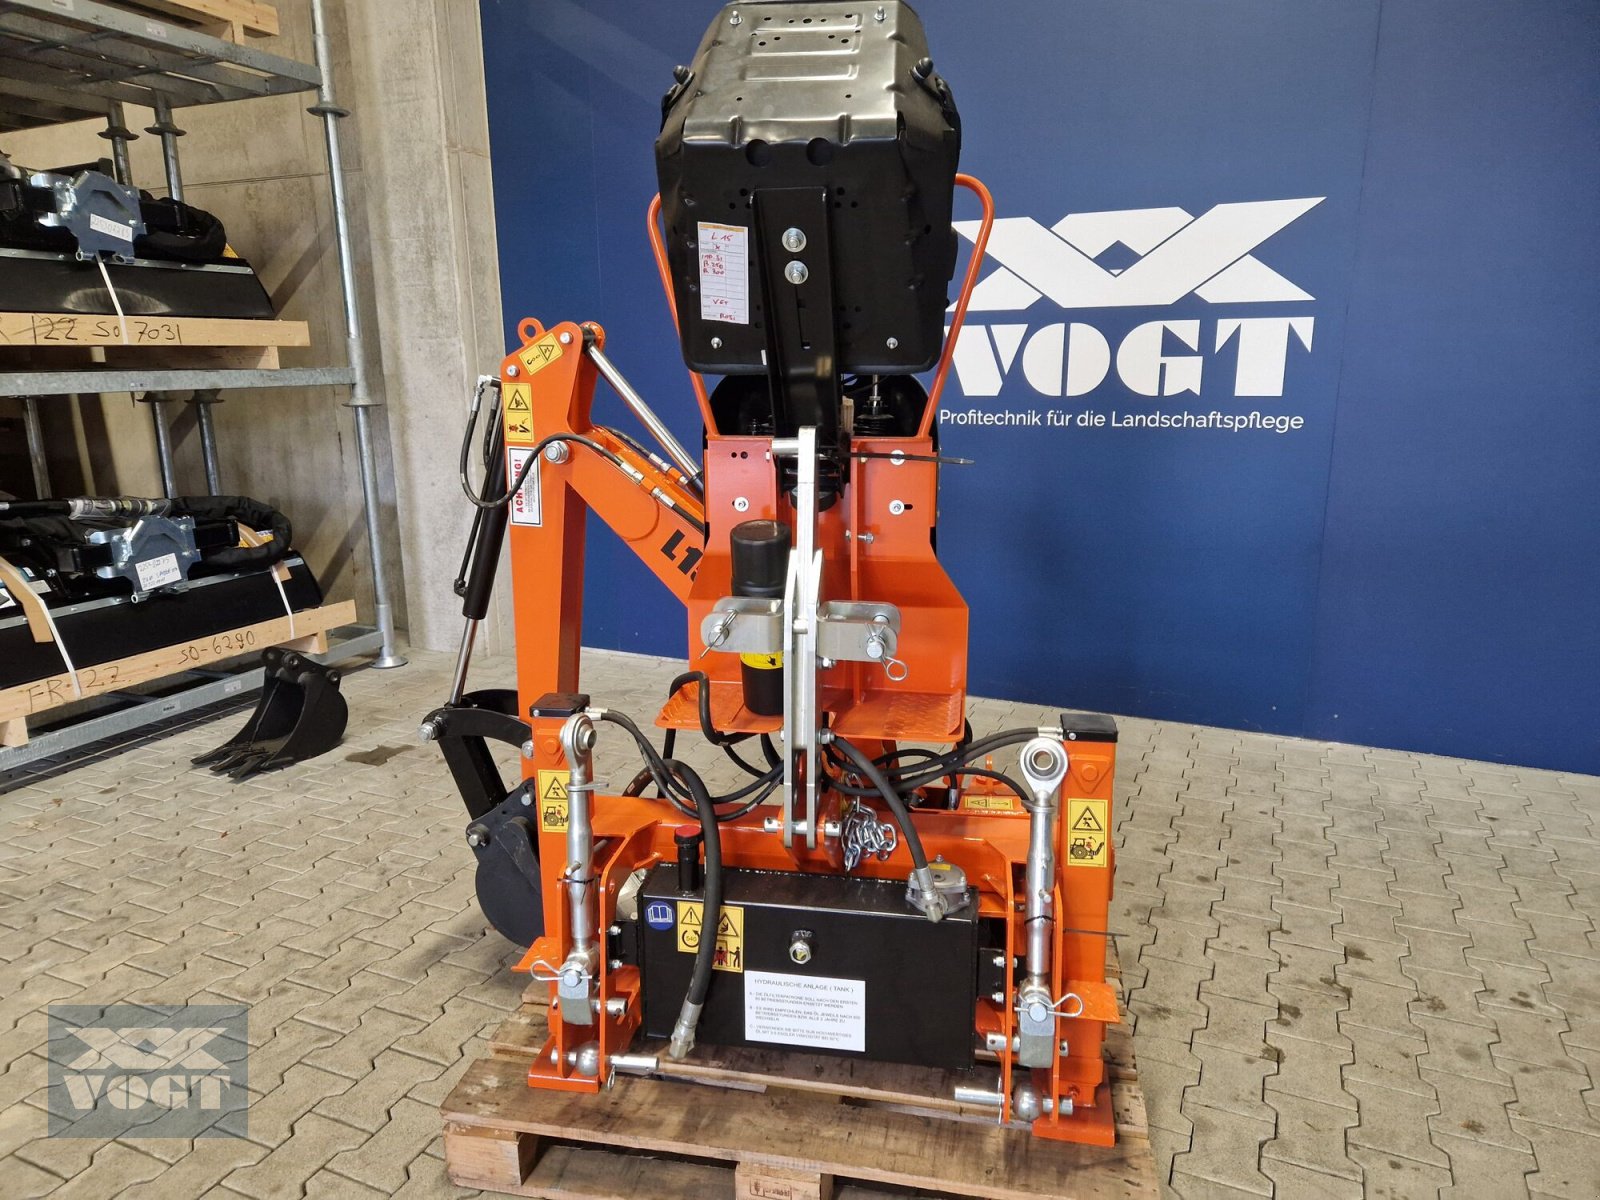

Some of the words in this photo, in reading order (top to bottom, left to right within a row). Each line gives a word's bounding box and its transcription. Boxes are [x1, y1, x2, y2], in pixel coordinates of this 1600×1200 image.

[943, 316, 1314, 397] VOGT
[940, 409, 1041, 427] Profitechnik
[1047, 410, 1072, 428] für
[1077, 411, 1106, 428] die
[1112, 411, 1305, 434] Landschaftspflege
[802, 982, 827, 990] ANLAGE
